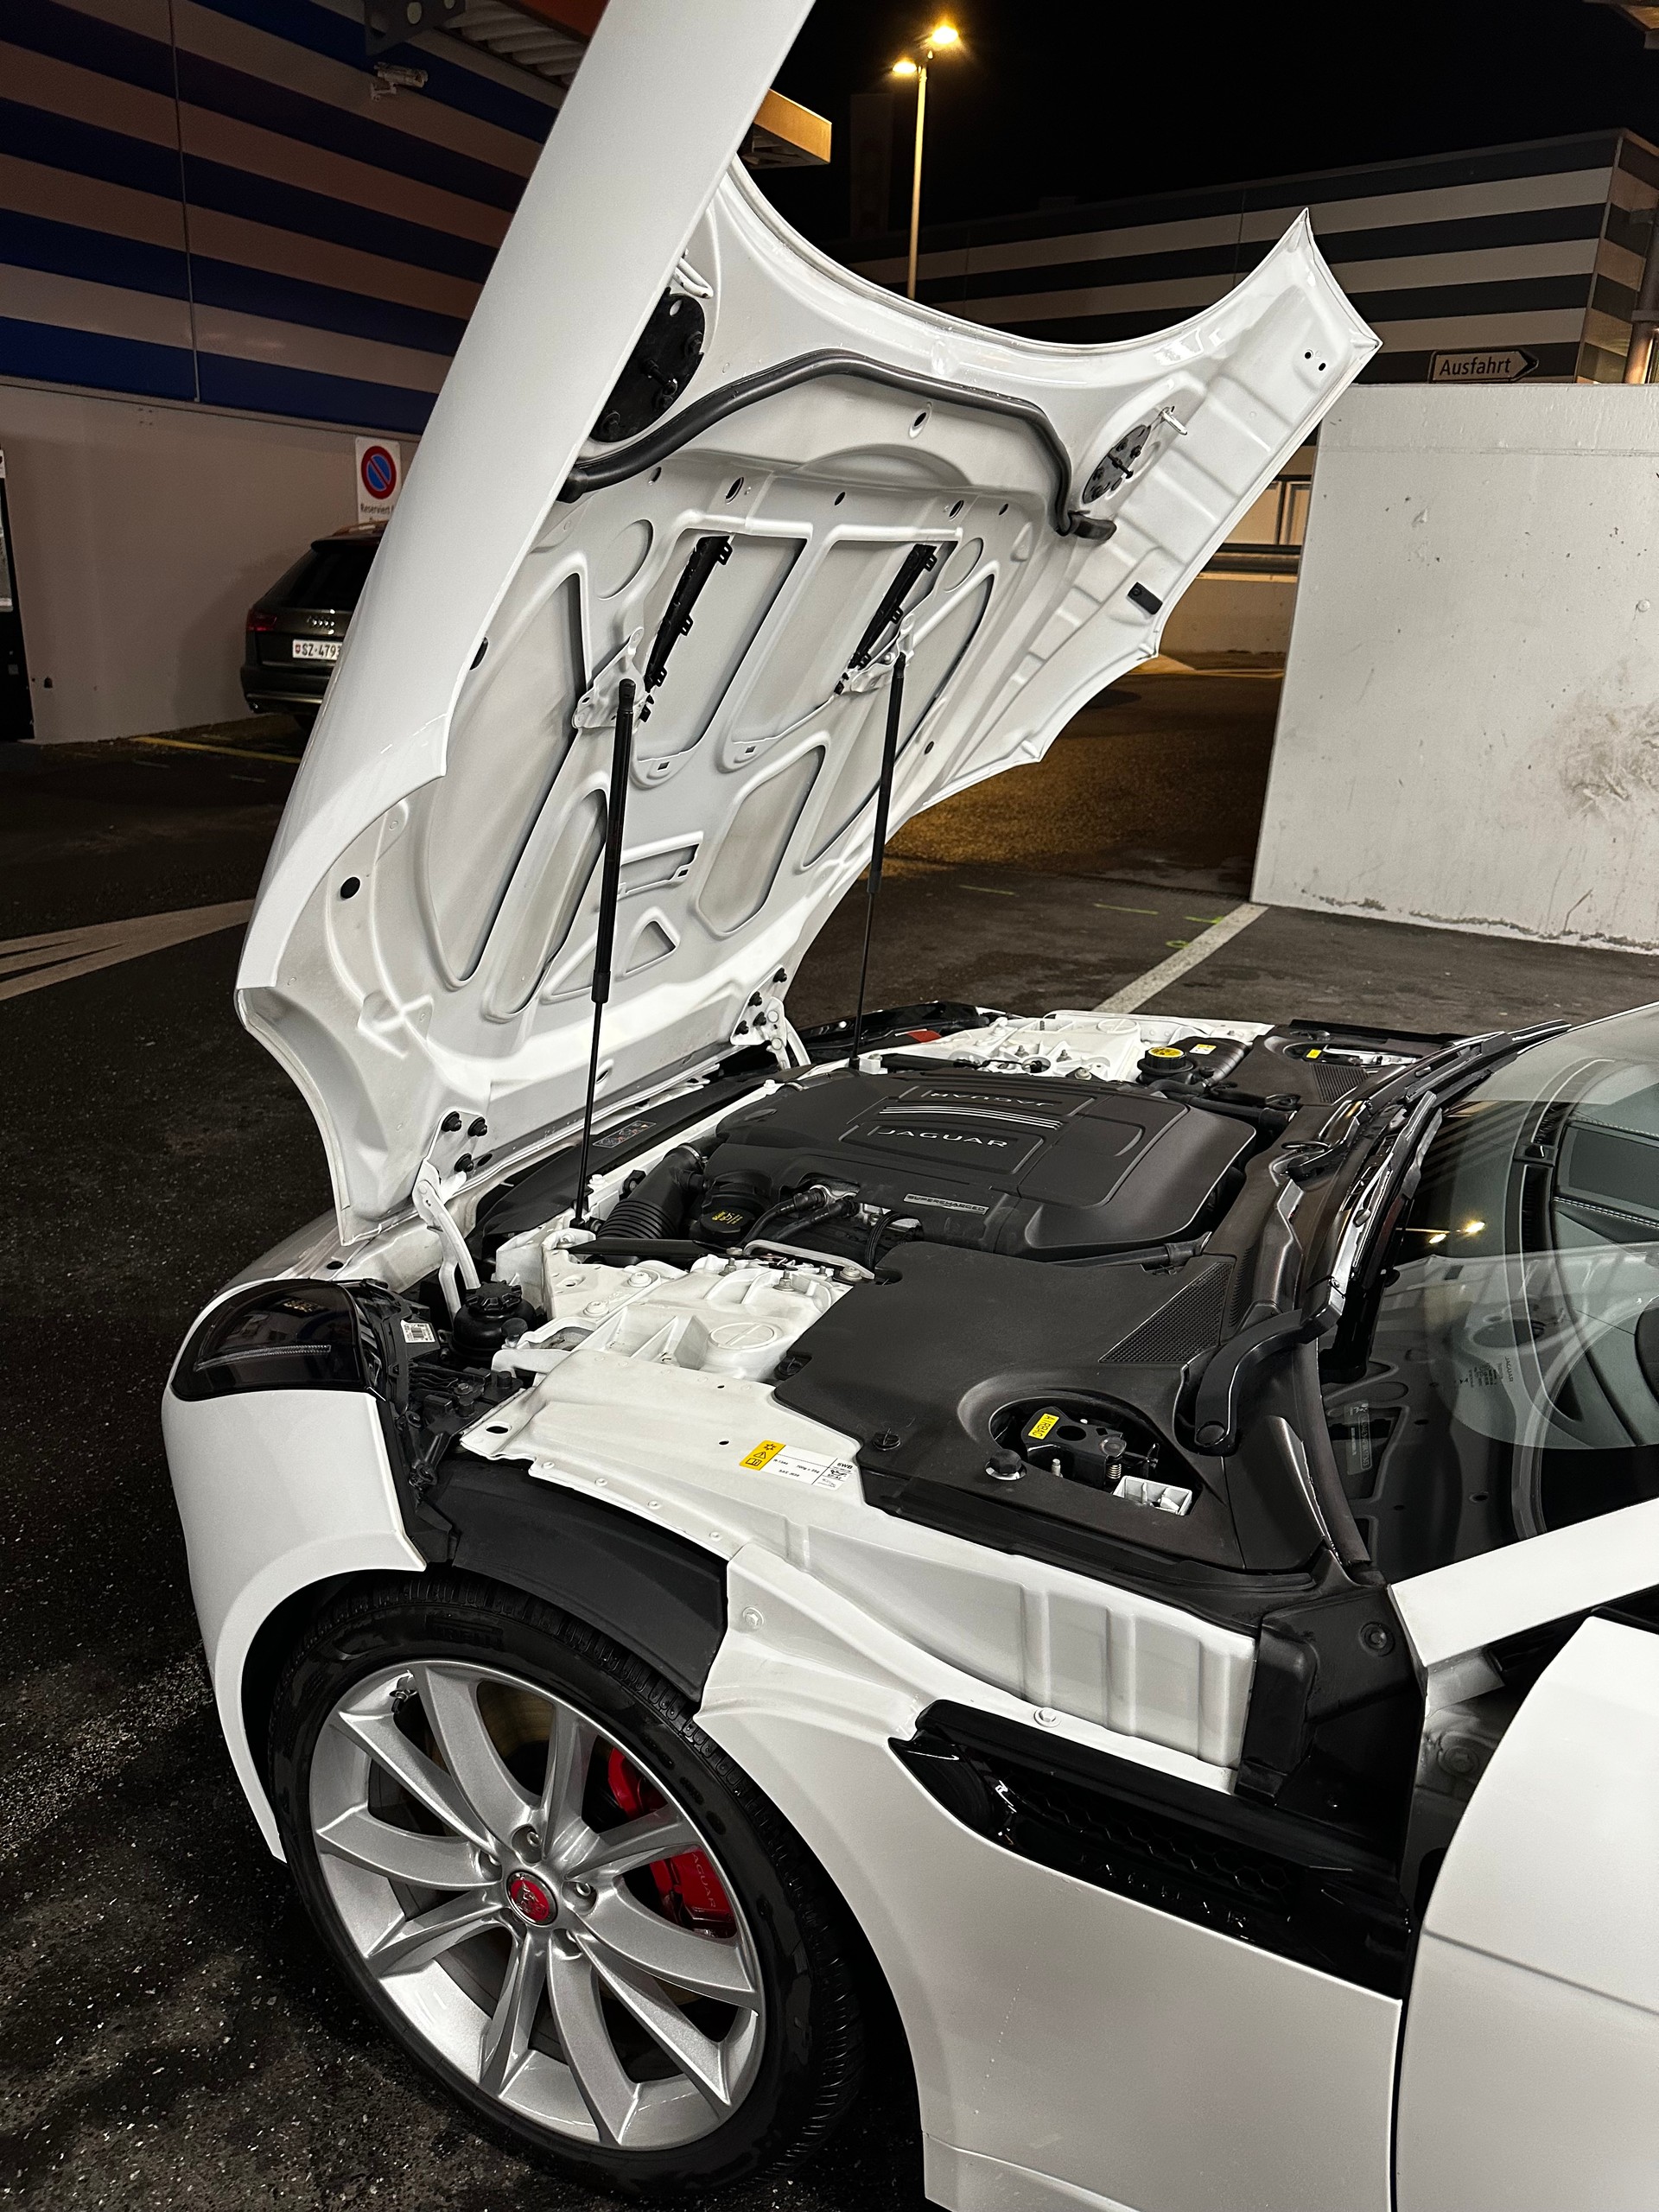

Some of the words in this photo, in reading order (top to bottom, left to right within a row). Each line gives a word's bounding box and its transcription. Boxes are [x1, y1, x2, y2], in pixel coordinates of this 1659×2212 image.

[1439, 356, 1511, 376] Ausfahrt
[360, 502, 391, 516] Reserviert
[930, 1092, 1054, 1107] JAGUAR
[877, 1129, 1007, 1147] JAGUAR
[906, 1195, 985, 1211] SUPERCHARGED
[1504, 1356, 1515, 1383] JAGUAR
[1033, 1414, 1056, 1437] AIRBAG
[691, 1853, 716, 1908] AGUAR
